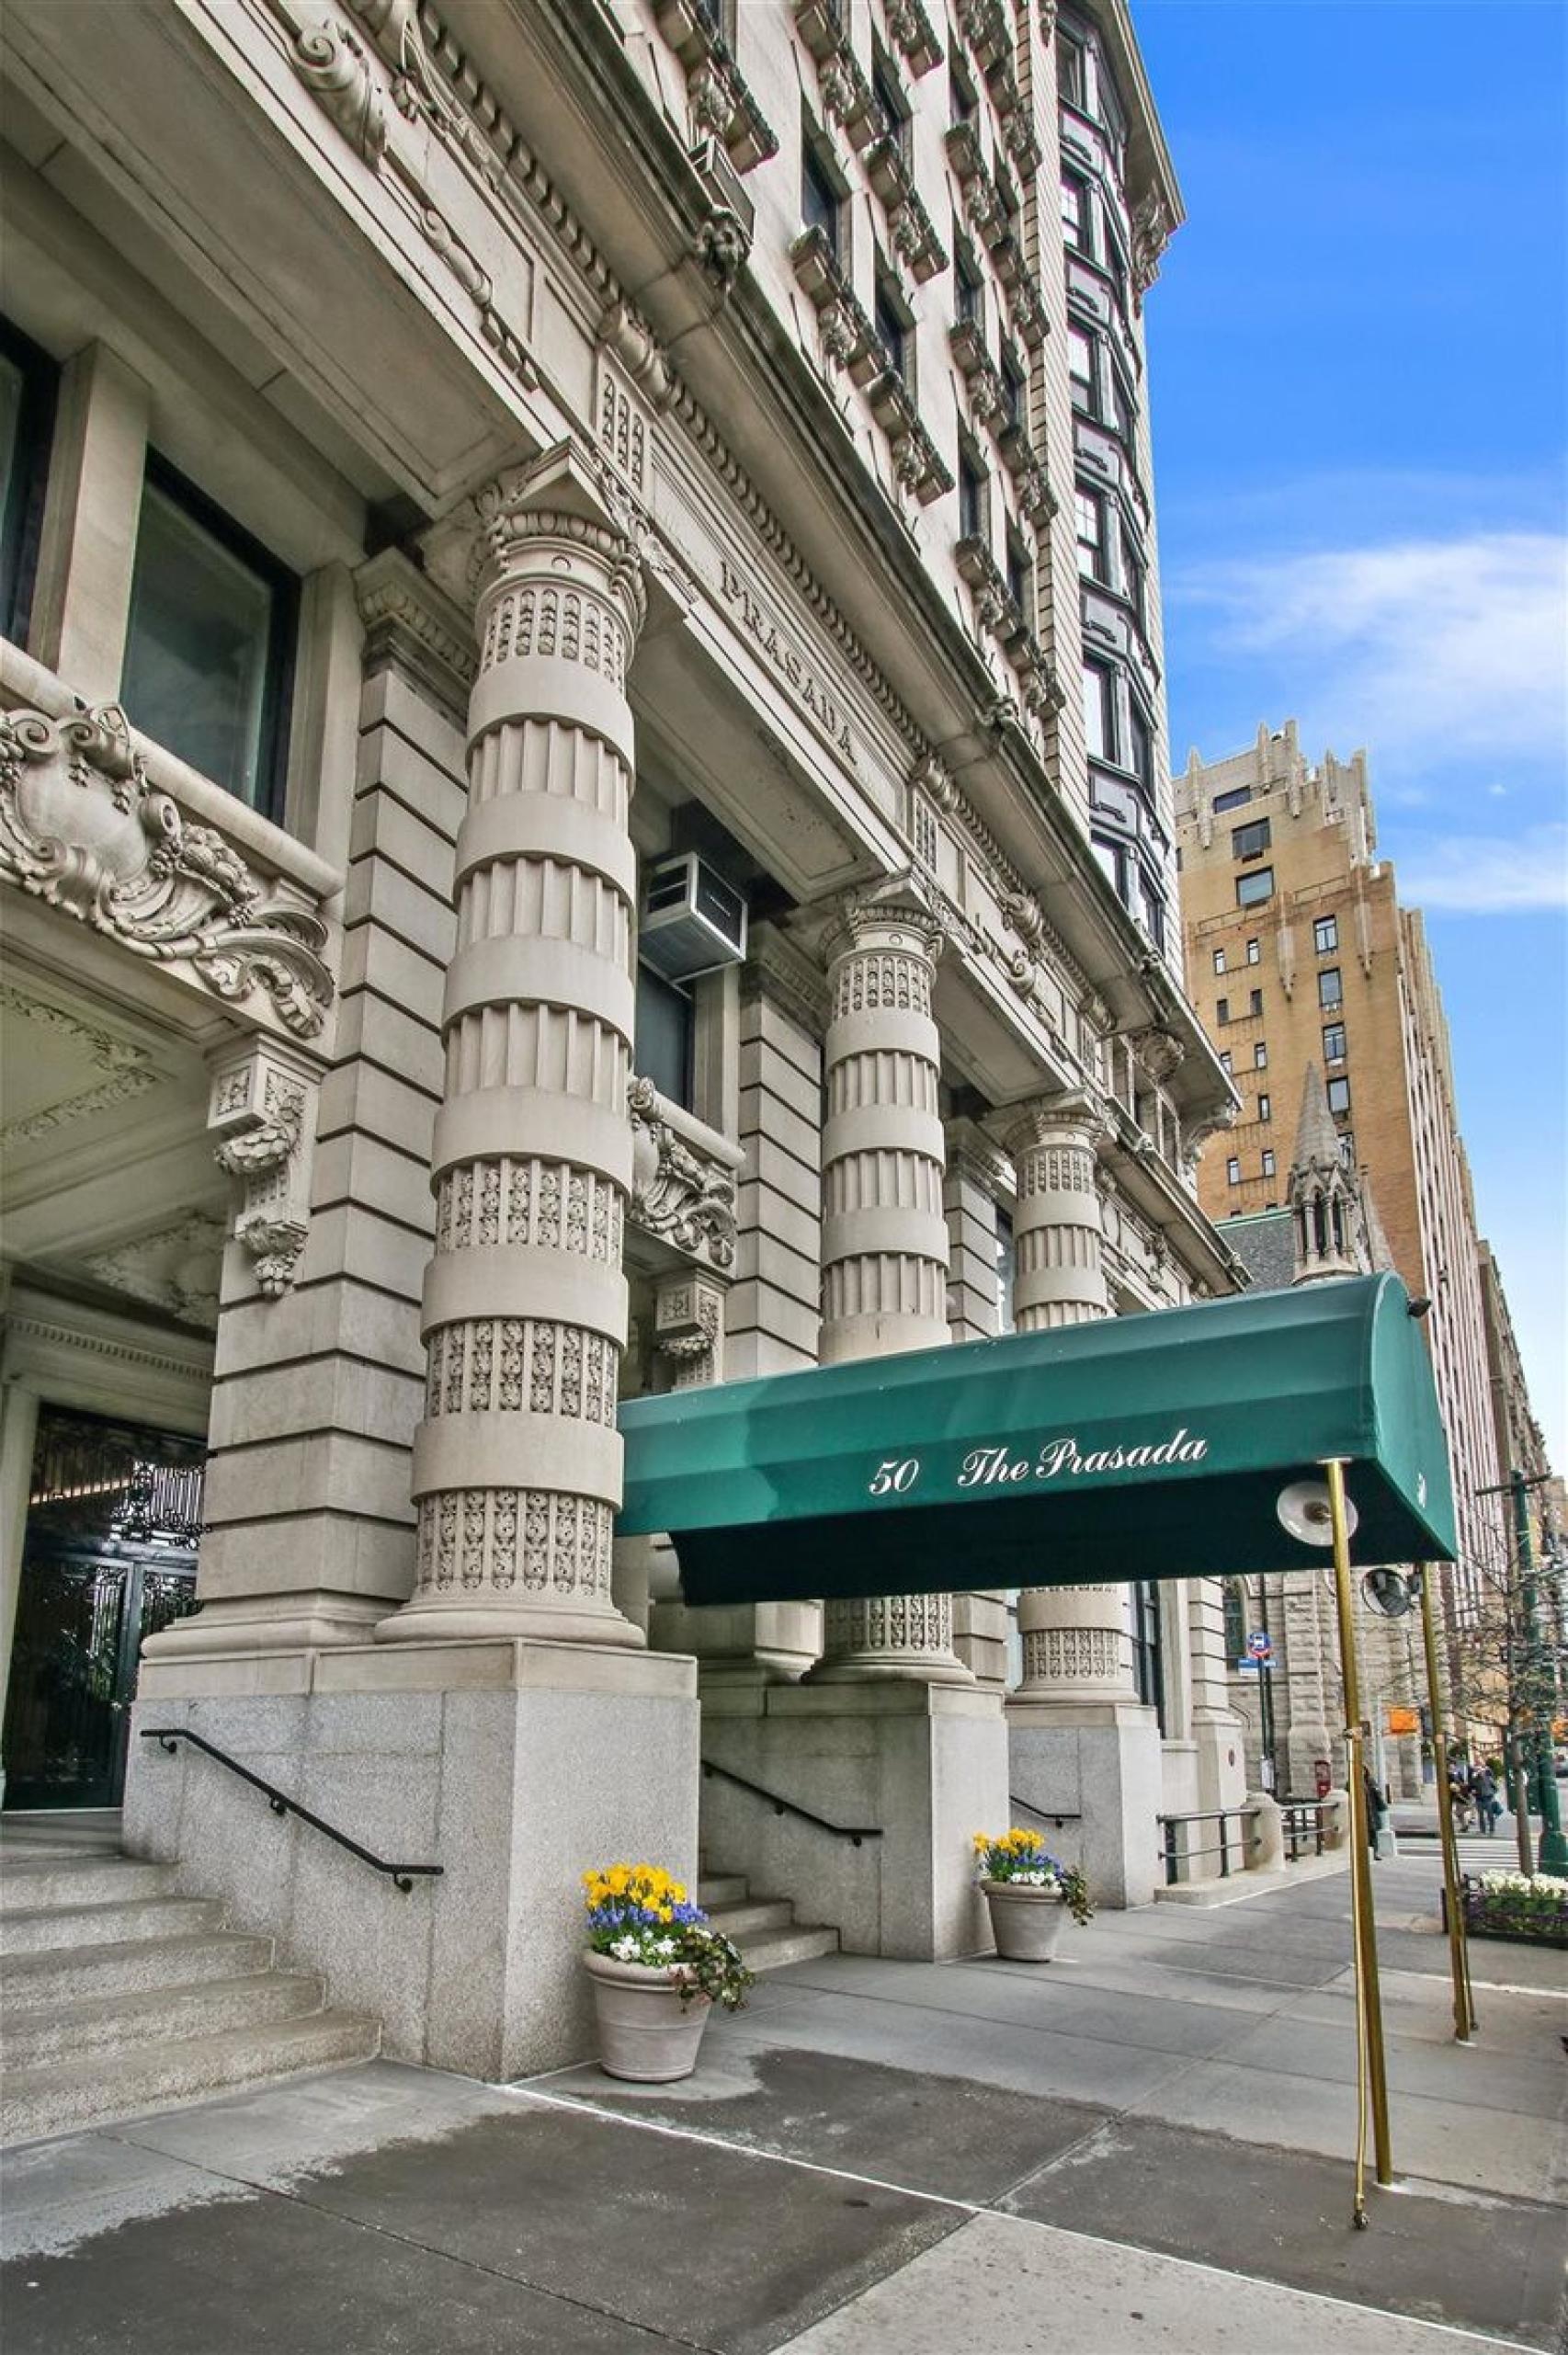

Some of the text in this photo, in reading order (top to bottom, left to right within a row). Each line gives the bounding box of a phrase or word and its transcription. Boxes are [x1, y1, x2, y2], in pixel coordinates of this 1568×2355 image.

[720, 561, 858, 766] PRASADA
[869, 1428, 1208, 1496] 50 The Prasada
